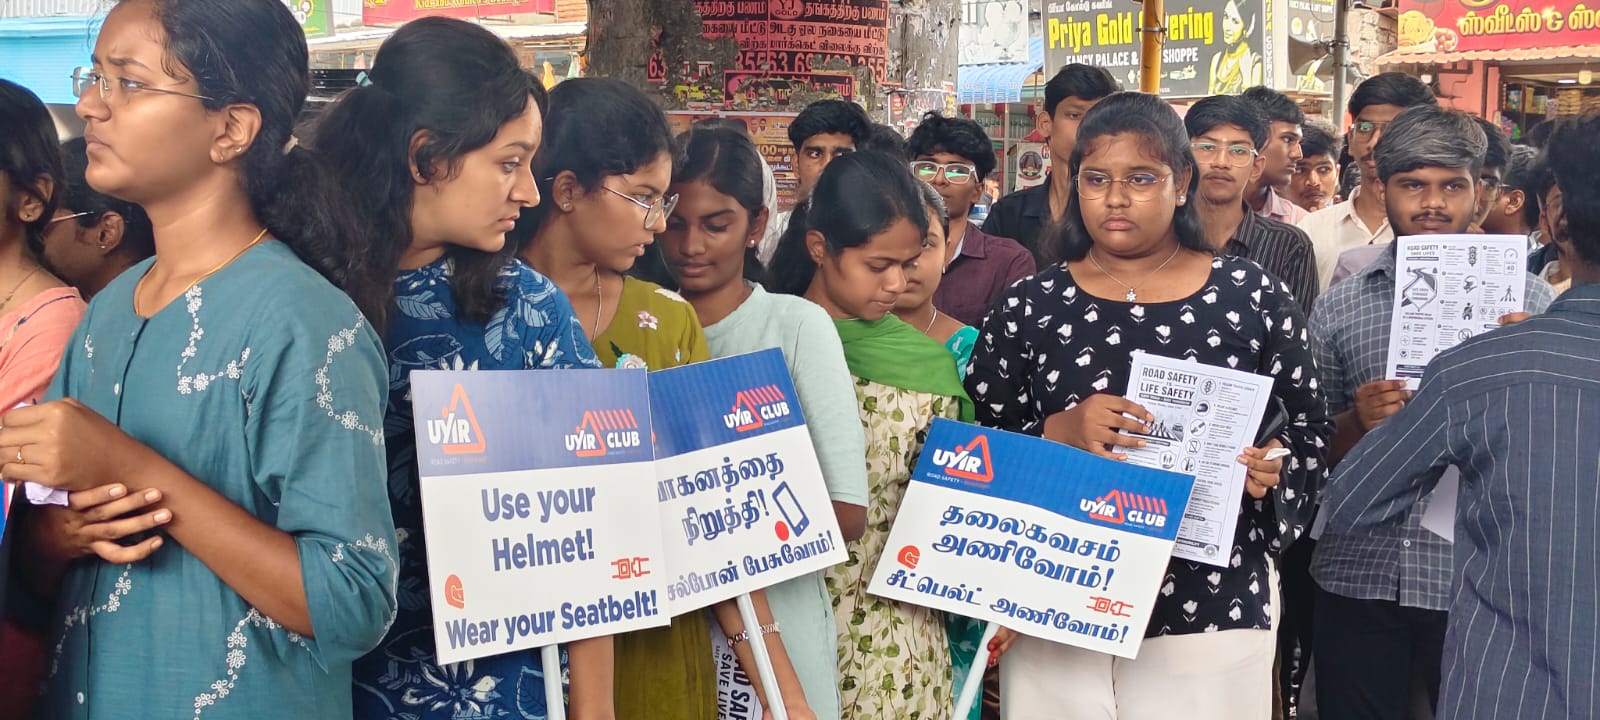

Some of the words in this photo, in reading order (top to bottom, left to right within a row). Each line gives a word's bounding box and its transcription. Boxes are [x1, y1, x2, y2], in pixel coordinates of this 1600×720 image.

[861, 2, 886, 20] பணம்
[1459, 4, 1543, 36] ஸ்வீட்ஸ்
[769, 22, 797, 37] அடகு
[1048, 16, 1092, 53] Priya
[1096, 12, 1133, 46] Gold
[1095, 51, 1129, 66] PALACE
[1131, 51, 1139, 66] &
[1162, 47, 1199, 64] SHOPPE
[1140, 382, 1160, 394] LIFE
[1161, 386, 1195, 400] SAFETY
[1142, 367, 1166, 380] ROAD
[1167, 371, 1198, 385] SAFETY
[427, 412, 471, 445] UYIR
[723, 407, 753, 429] UYIR
[760, 401, 790, 418] CLUB
[564, 429, 596, 451] UYIR
[606, 431, 641, 448] CLUB
[932, 448, 982, 474] UYIR
[941, 475, 960, 484] SAFETY
[481, 486, 530, 522] Use
[538, 485, 596, 524] your
[681, 488, 770, 547] நிறுத்தி!
[1079, 498, 1116, 518] UYIR
[1127, 509, 1166, 528] CLUB
[491, 528, 596, 572] Helmet!
[939, 504, 1121, 564] தலைகவசம்
[667, 560, 740, 601] சல்போன்
[742, 529, 836, 577] பேசுவோம்!
[931, 533, 1116, 592] அணிவோம்!
[445, 616, 500, 650] Wear
[503, 608, 556, 644] your
[560, 589, 659, 631] Seatbelt!
[886, 568, 983, 606] சீட்பெல்ட்
[989, 596, 1130, 644] அணிவோம்!
[719, 652, 733, 688] SAVE
[717, 690, 729, 720] LIVE
